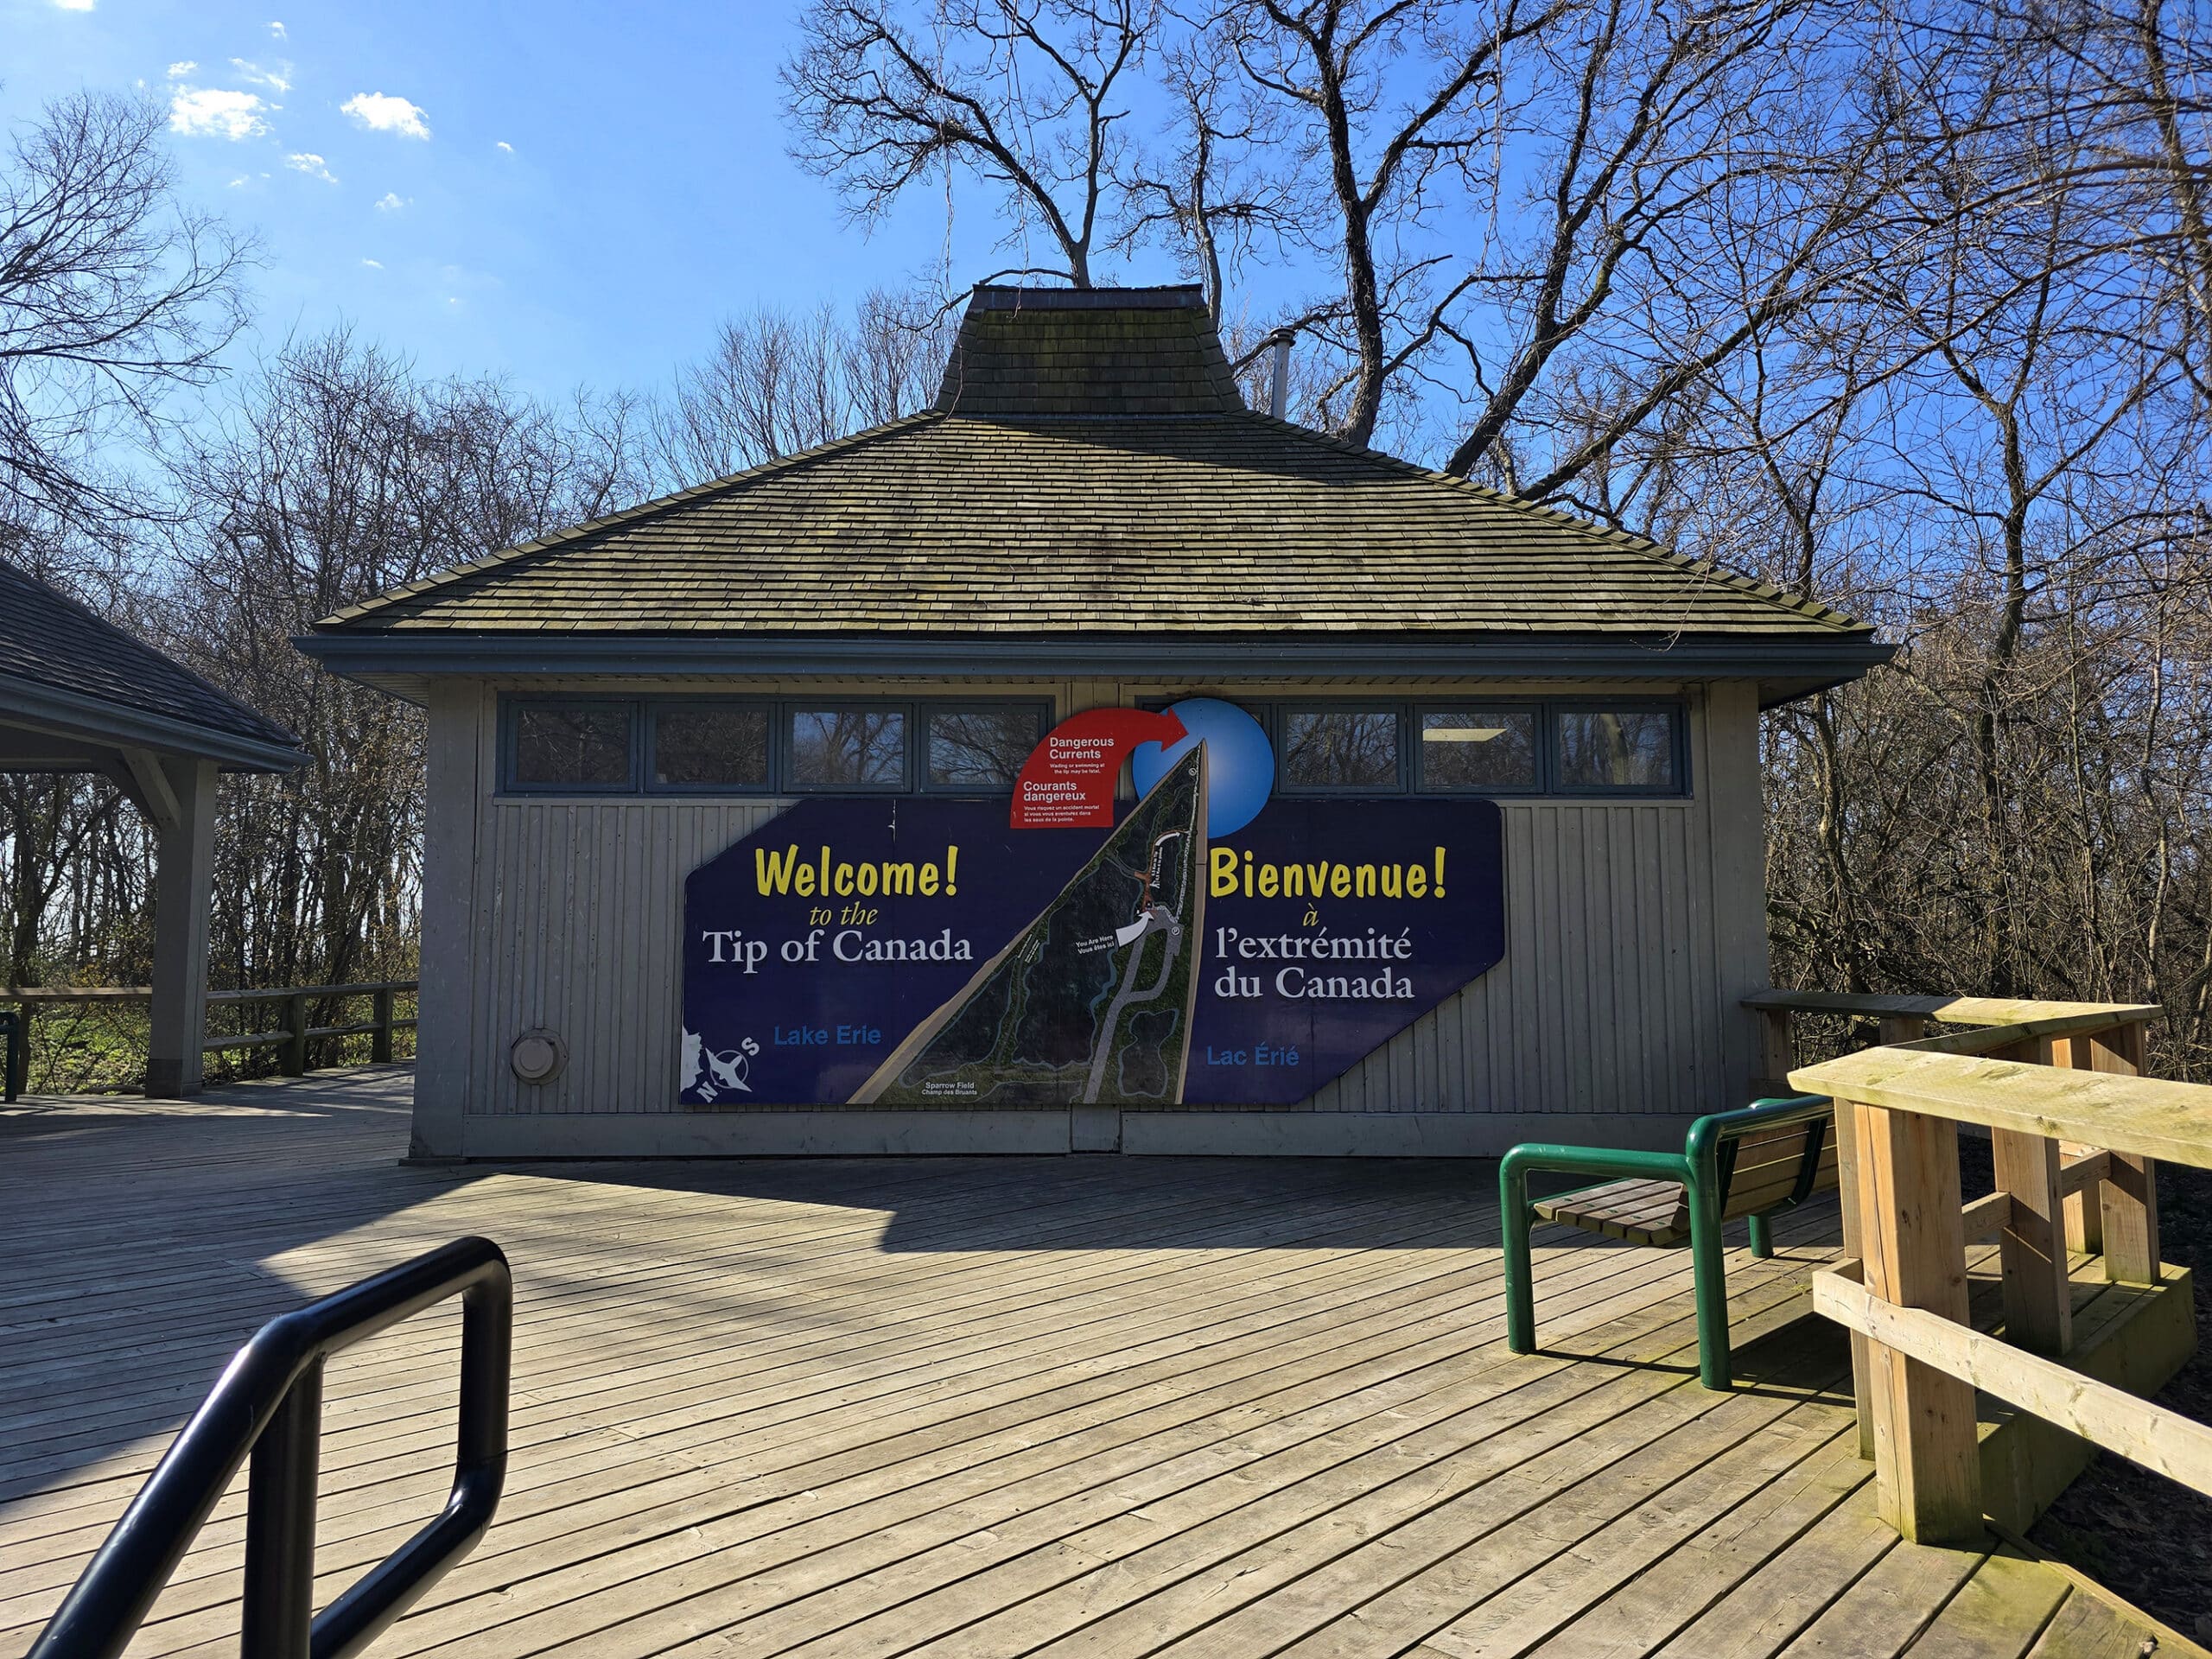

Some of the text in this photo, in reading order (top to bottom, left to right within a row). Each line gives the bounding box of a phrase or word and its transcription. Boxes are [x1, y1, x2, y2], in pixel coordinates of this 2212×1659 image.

[1049, 749, 1102, 760] Currents
[1050, 737, 1115, 749] Dangerous
[1023, 780, 1077, 791] Courants
[1023, 791, 1086, 803] dangereux
[755, 844, 959, 897] Welcome!
[1210, 847, 1446, 899] Bienvenue!
[809, 901, 879, 926] to the
[1303, 902, 1319, 927] à
[702, 928, 974, 974] Tip of Canada
[1214, 965, 1415, 999] du Canada
[741, 1036, 760, 1057] S
[773, 1025, 881, 1046] Lake Erie
[1206, 1040, 1300, 1066] Lac Érié
[696, 1082, 720, 1103] N
